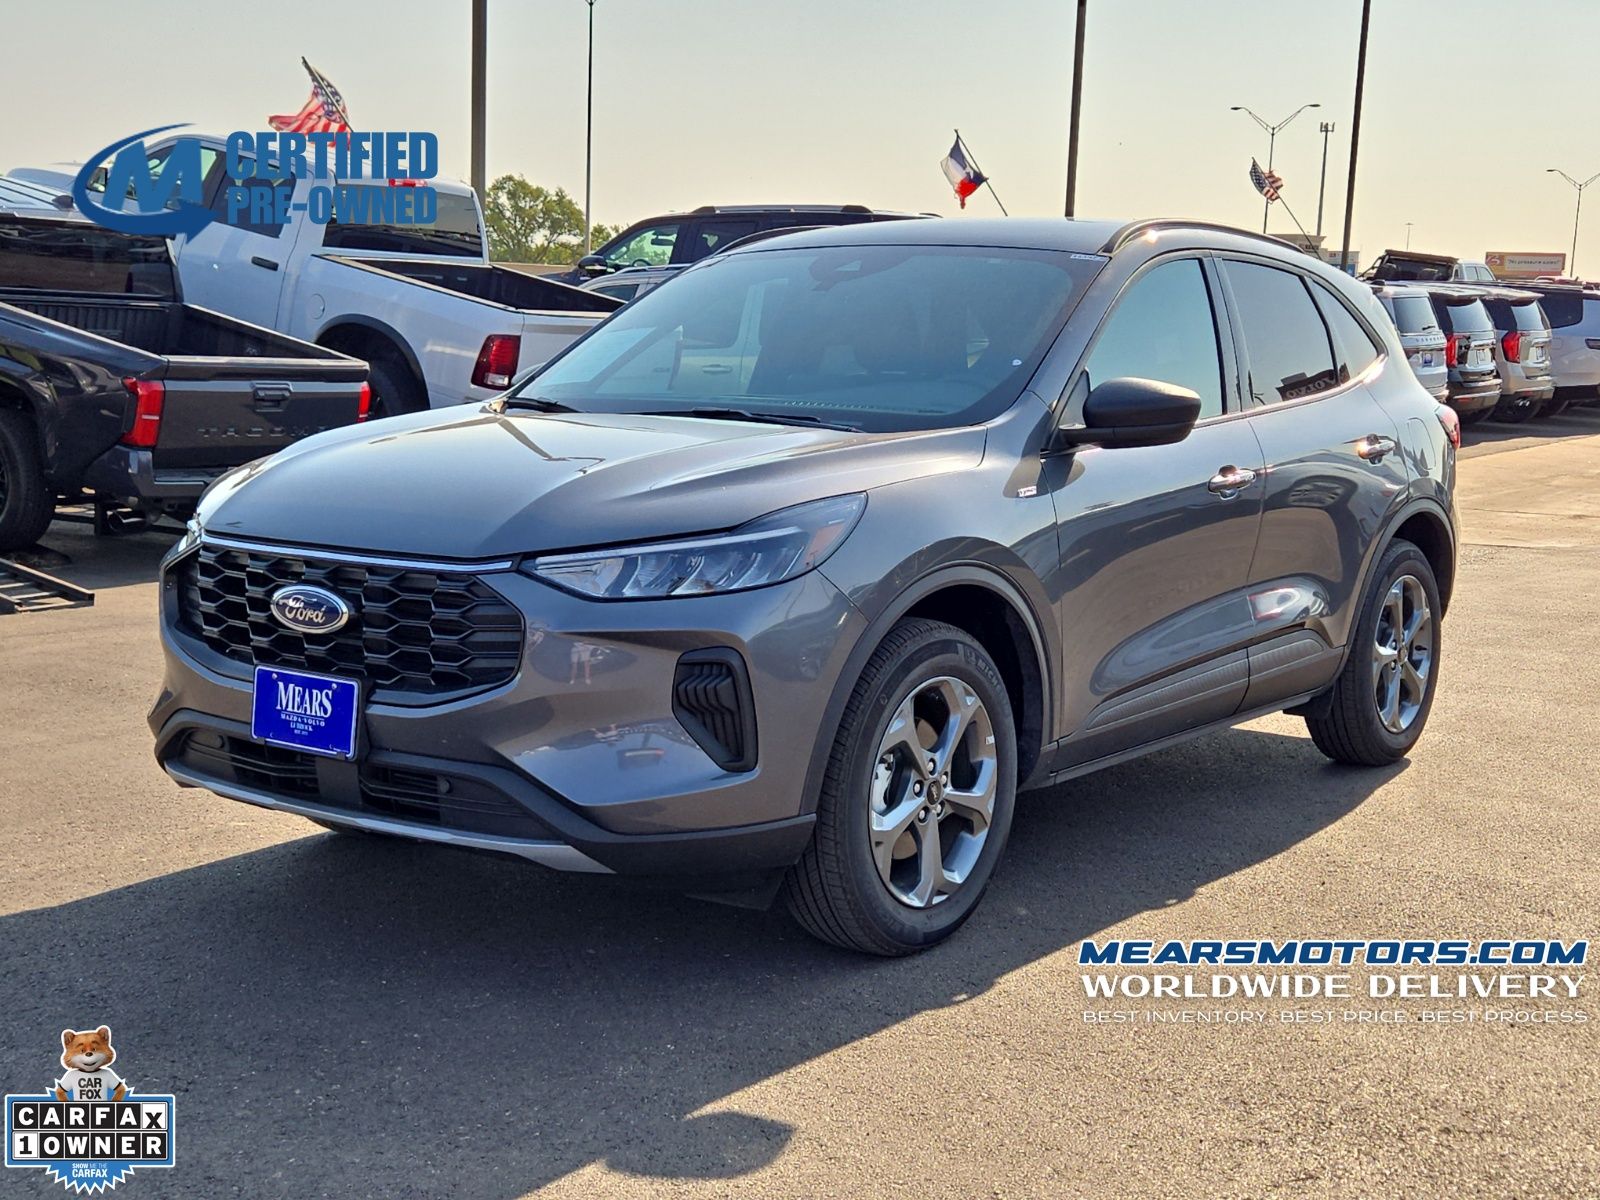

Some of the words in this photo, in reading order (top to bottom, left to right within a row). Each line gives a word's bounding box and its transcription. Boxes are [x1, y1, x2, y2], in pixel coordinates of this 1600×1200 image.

[197, 426, 327, 438] TACOM
[279, 594, 326, 625] Ford
[276, 682, 333, 719] MEARS
